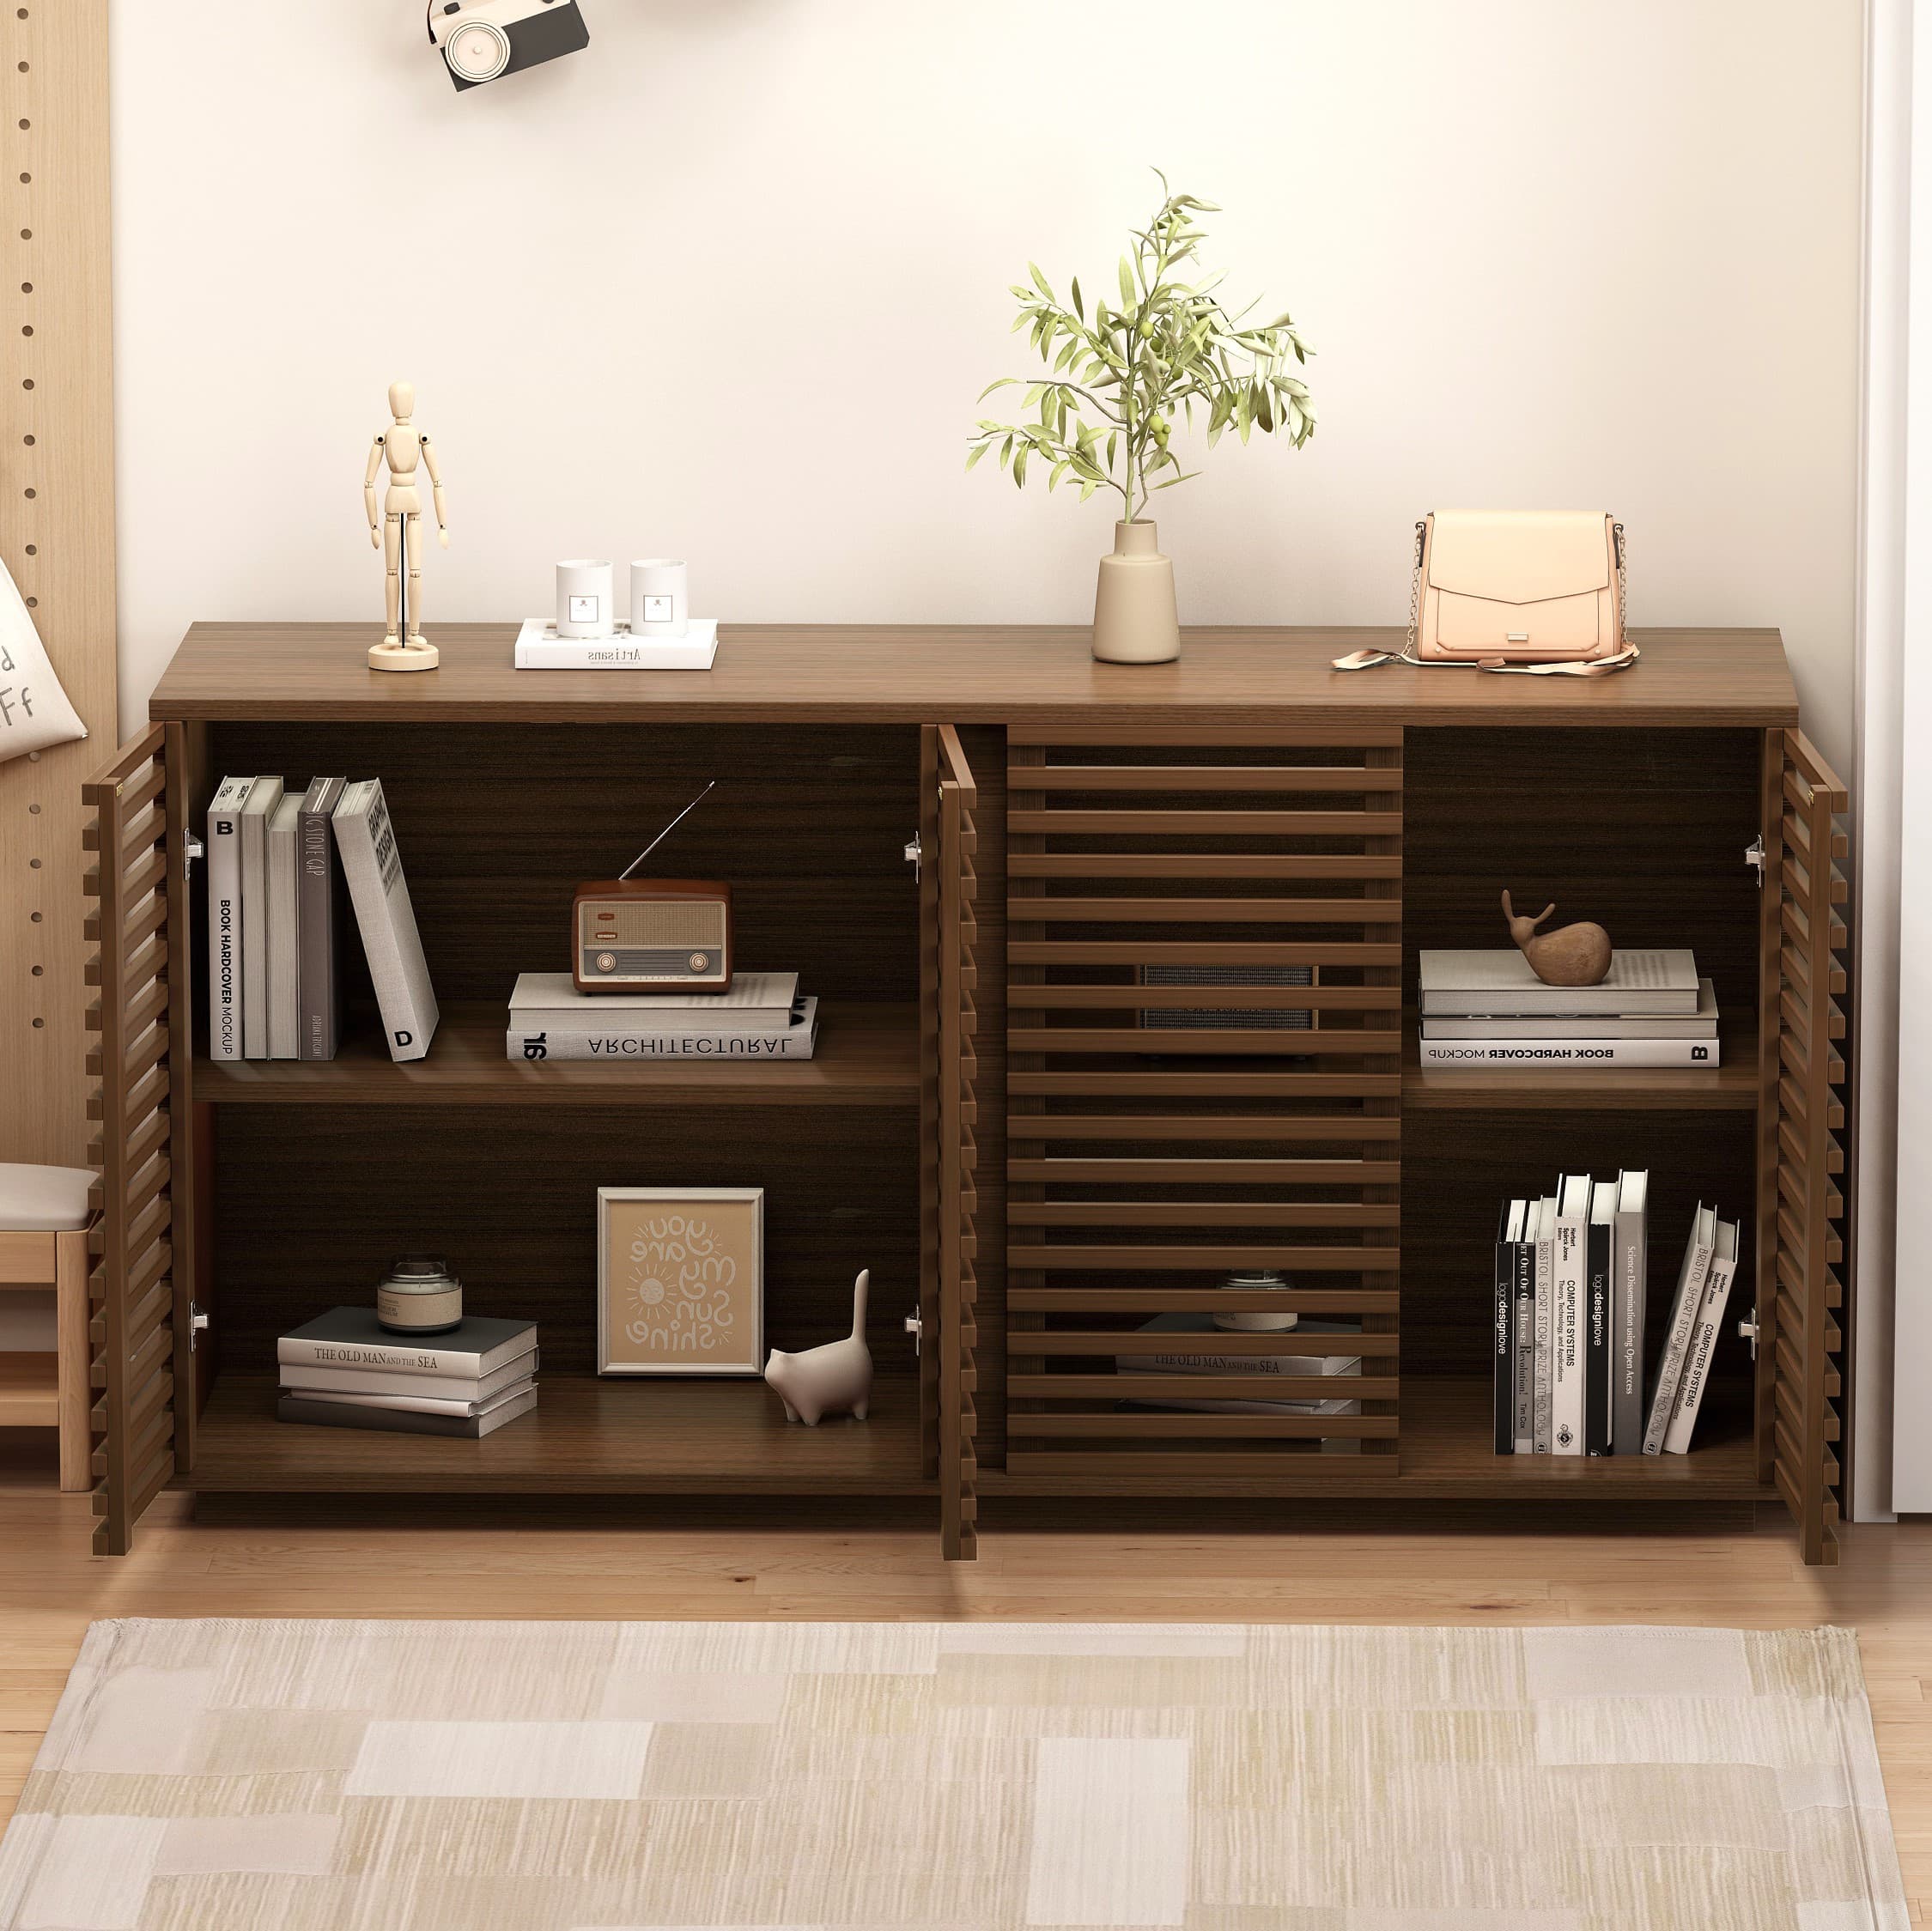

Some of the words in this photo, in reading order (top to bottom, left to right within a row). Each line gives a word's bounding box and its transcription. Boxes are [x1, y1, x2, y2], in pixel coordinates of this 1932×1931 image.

[216, 821, 234, 835] B
[306, 829, 325, 855] STONE
[306, 859, 325, 876] GAP
[220, 899, 231, 932] BOOK
[221, 934, 232, 1005] HARDCOVER
[222, 1006, 233, 1054] MOCKUP
[394, 1030, 413, 1047] D
[1538, 1242, 1548, 1278] BRISTOL
[1627, 1246, 1637, 1273] Science
[1691, 1248, 1709, 1283] BRISTOL
[1538, 1281, 1548, 1311] SHORT
[1718, 1273, 1728, 1293] Herbert
[1566, 1280, 1576, 1327] COMPUTER
[1626, 1276, 1636, 1325] Dissemination
[1682, 1287, 1698, 1317] SHORT
[1566, 1328, 1575, 1367] SYSTEMS
[1625, 1327, 1636, 1347] using
[1695, 1324, 1715, 1369] COMPUTER
[314, 1347, 337, 1360] THE
[337, 1350, 361, 1362] OLD
[363, 1352, 386, 1363] MAN
[386, 1357, 401, 1365] AND
[402, 1357, 416, 1366] THE
[417, 1356, 438, 1369] SEA
[1154, 1355, 1176, 1365] THE
[1177, 1355, 1201, 1366] OLD
[1203, 1357, 1226, 1369] MAN
[1259, 1360, 1279, 1373] SEA
[1518, 1345, 1532, 1395] Revolution!
[1536, 1349, 1547, 1374] PRIZE
[1625, 1348, 1635, 1369] Open
[1666, 1352, 1681, 1377] PRIZE
[1625, 1370, 1635, 1395] Access
[1685, 1369, 1703, 1408] SYSTEMS
